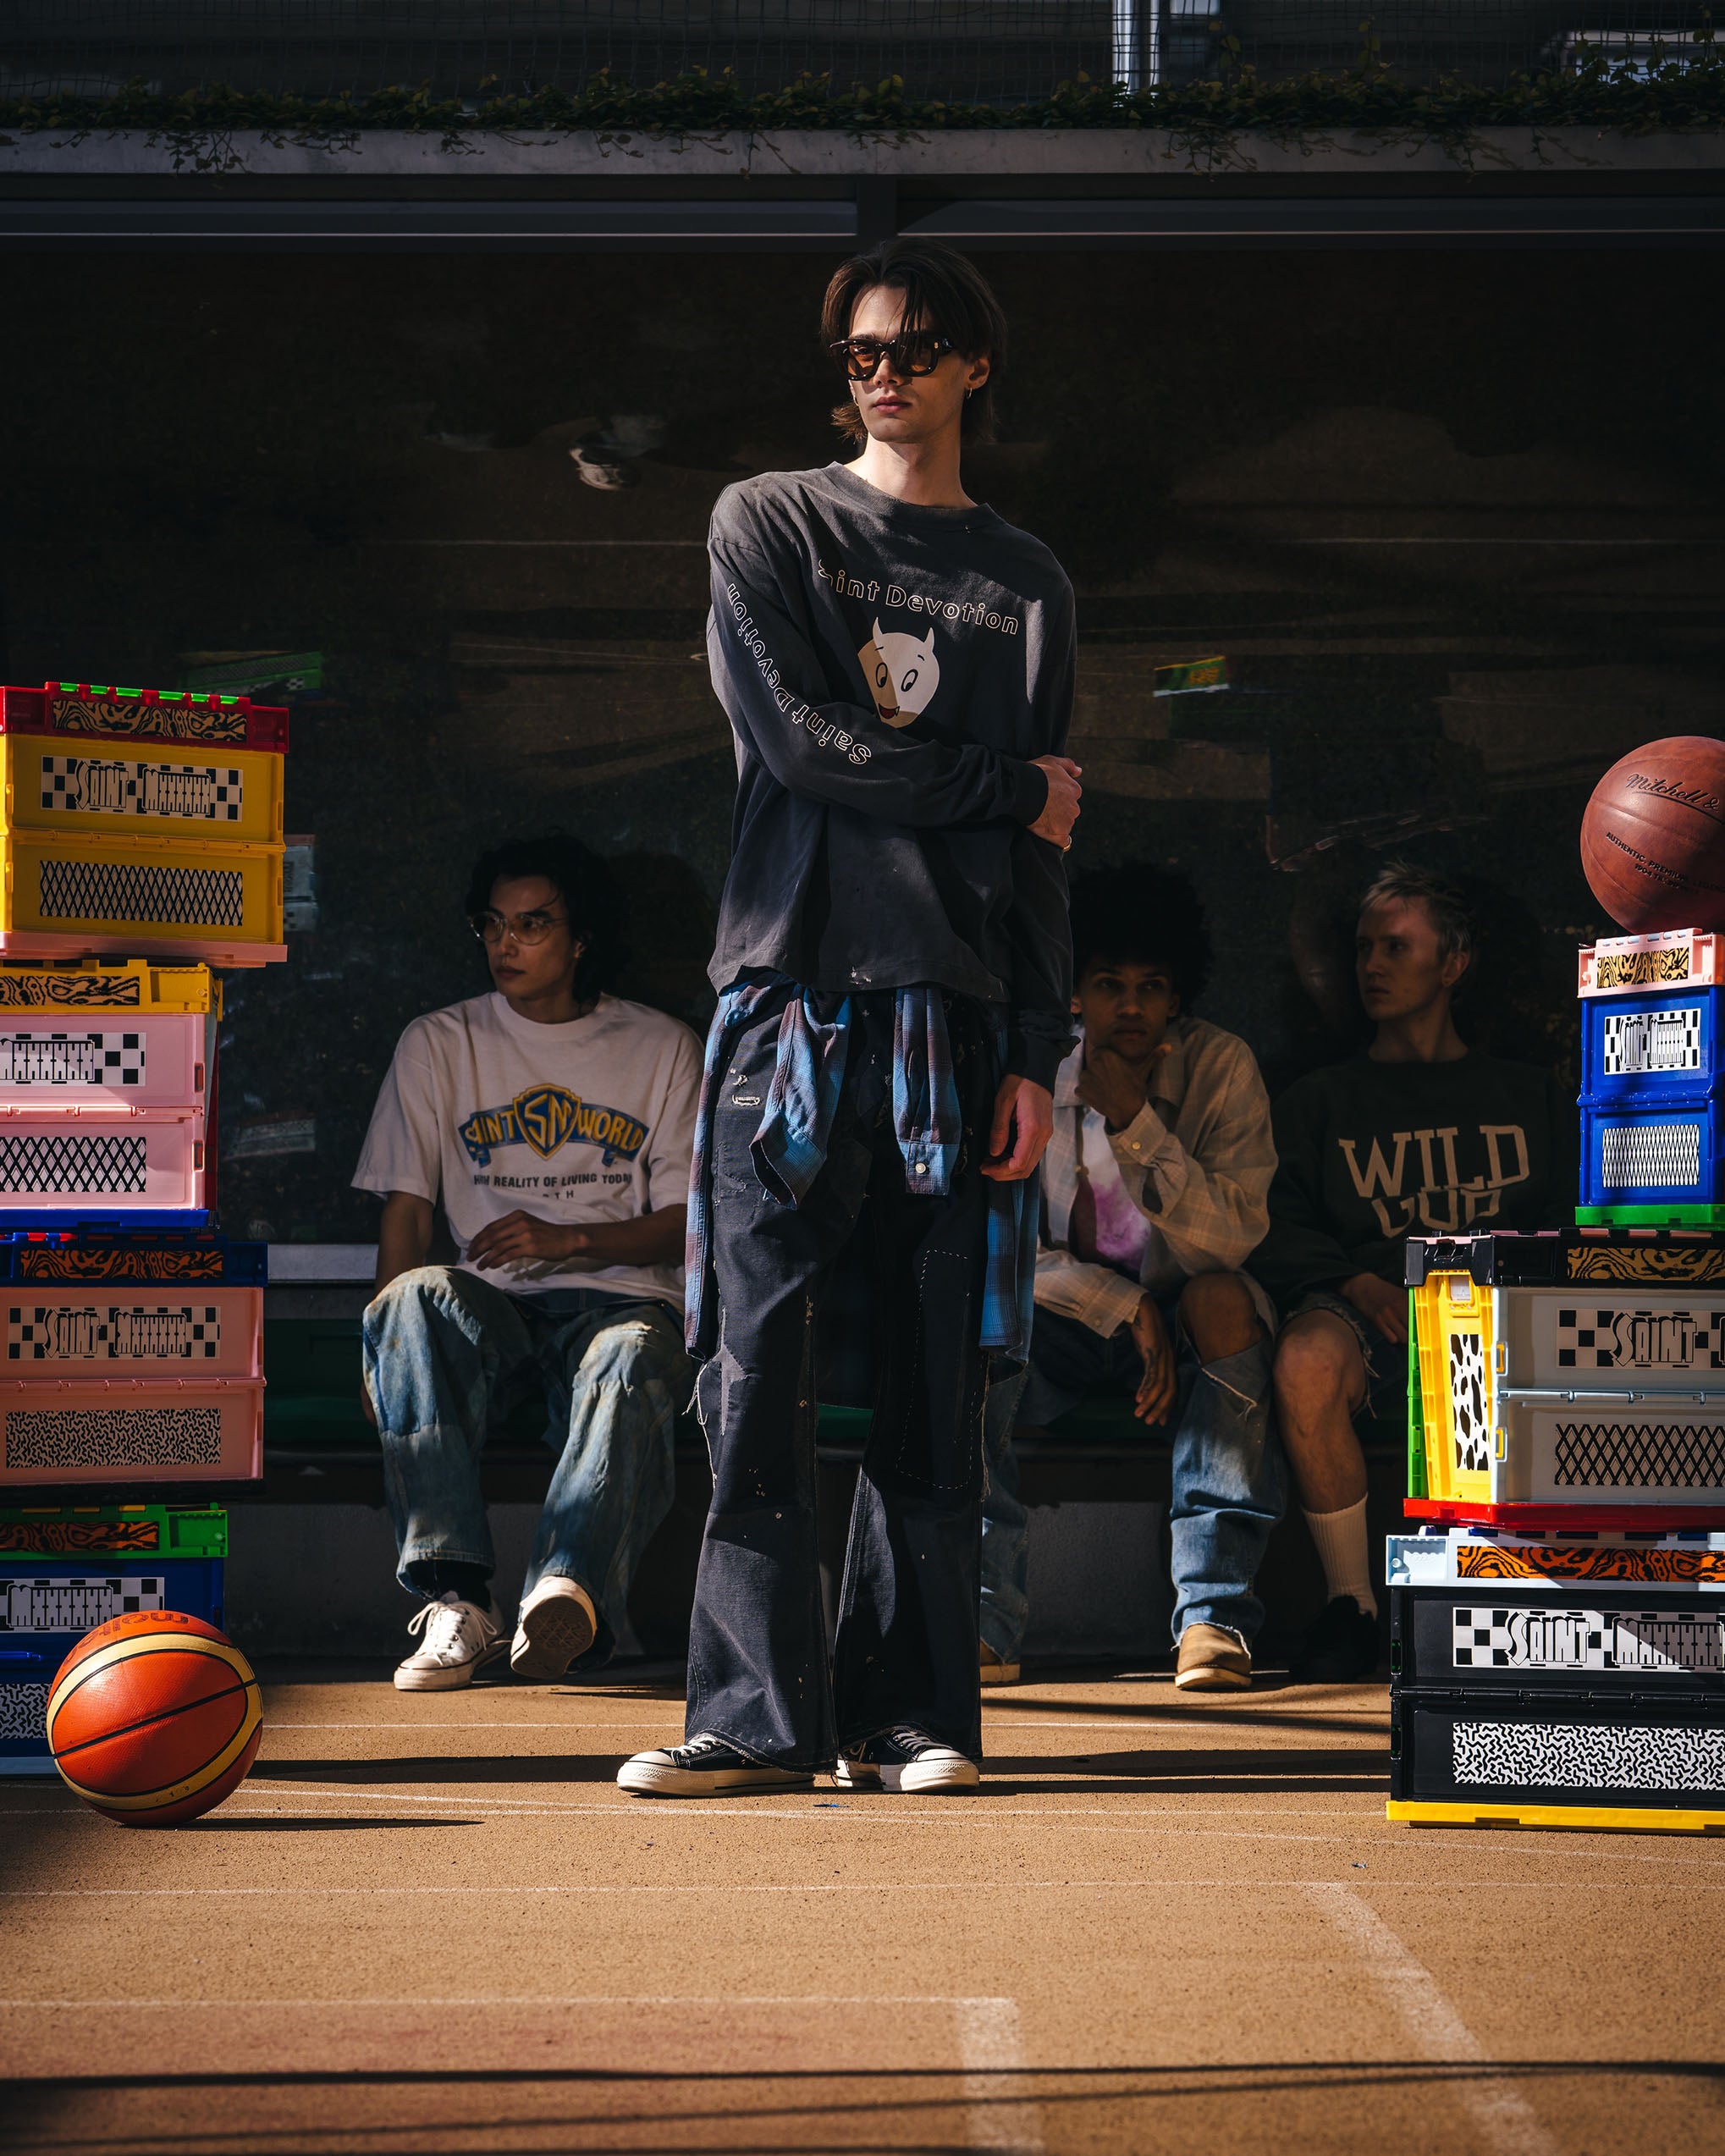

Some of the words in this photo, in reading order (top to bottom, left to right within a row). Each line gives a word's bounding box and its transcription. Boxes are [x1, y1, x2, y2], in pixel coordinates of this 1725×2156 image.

[818, 559, 880, 602] int
[885, 584, 1018, 636] Devotion
[726, 582, 796, 713] Devotion
[791, 703, 873, 765] Saint
[1625, 772, 1708, 804] Mitchell
[1702, 797, 1721, 812] &
[577, 1108, 644, 1152] WORLD
[493, 1175, 540, 1188] REALITY
[543, 1174, 557, 1187] OF
[561, 1172, 598, 1186] LIVING
[1338, 1124, 1530, 1198] WILD
[43, 1309, 101, 1359] SAINT
[1609, 1312, 1697, 1366] SAINT
[1504, 1612, 1591, 1667] SAINT
